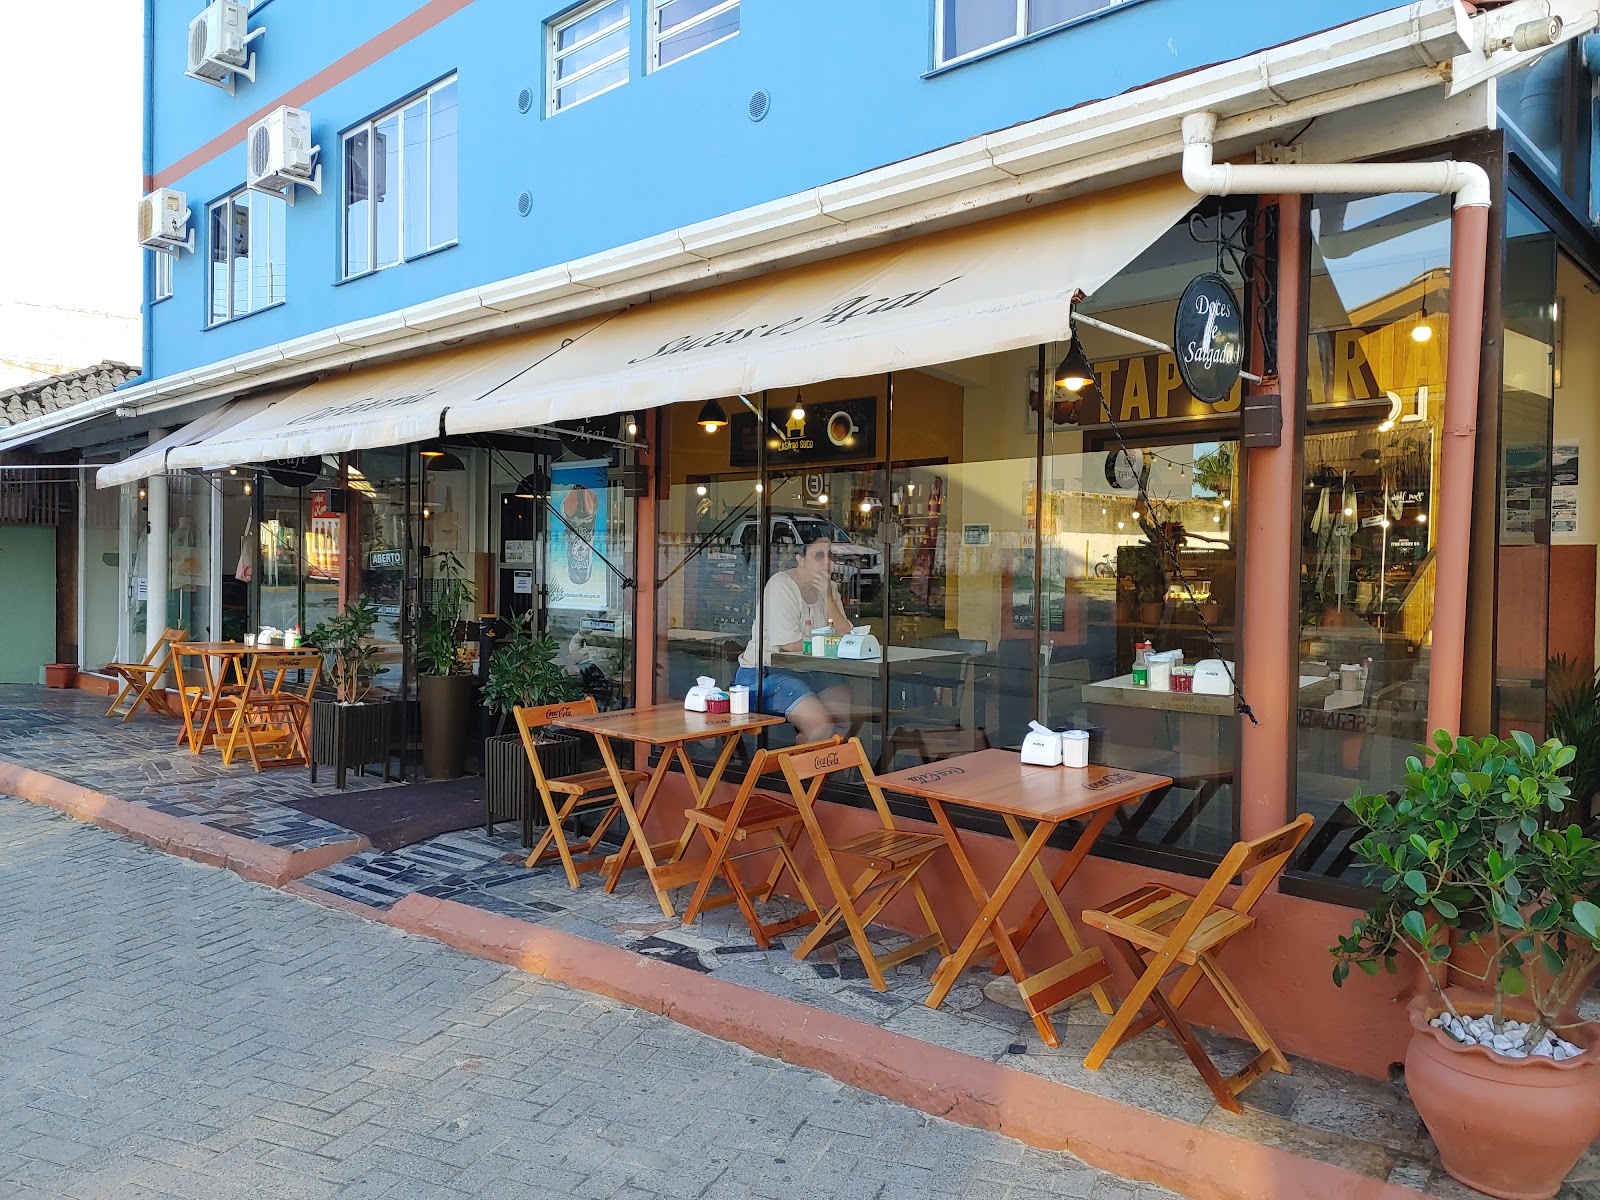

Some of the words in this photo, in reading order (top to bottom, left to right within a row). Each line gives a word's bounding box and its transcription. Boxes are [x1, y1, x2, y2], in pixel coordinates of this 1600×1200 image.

[1195, 294, 1231, 318] Doces
[799, 440, 814, 449] SUCO
[372, 552, 400, 564] ABERTO
